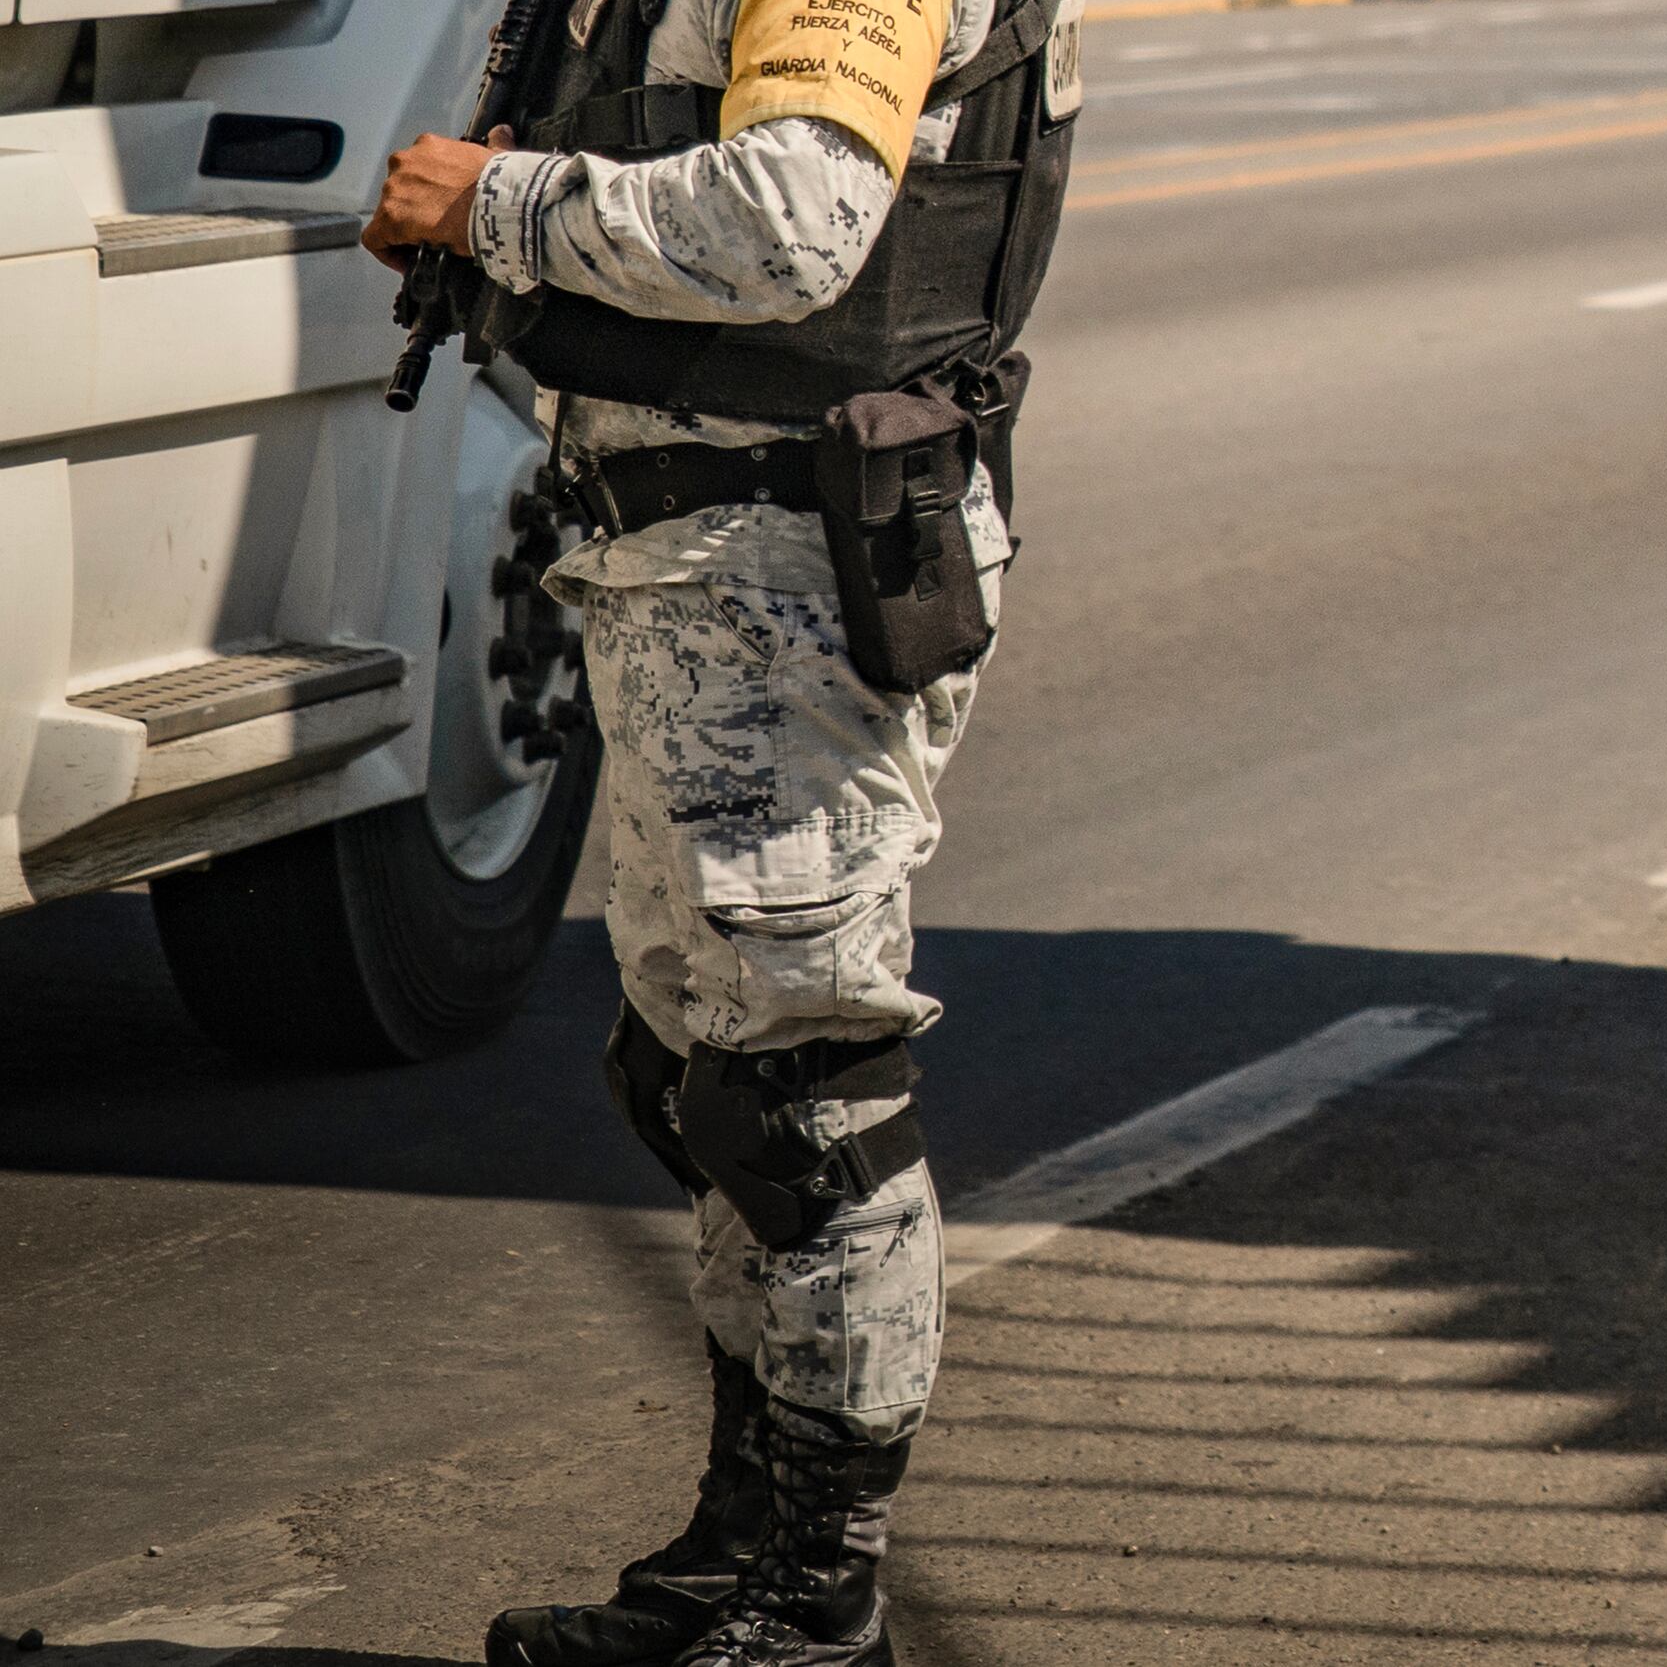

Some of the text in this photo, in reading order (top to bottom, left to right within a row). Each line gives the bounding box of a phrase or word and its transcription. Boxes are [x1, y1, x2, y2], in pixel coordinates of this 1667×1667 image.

[791, 15, 902, 60] FUERZA AÉREA
[842, 38, 853, 52] Y
[761, 58, 903, 116] GUARDIA NACIONAL
